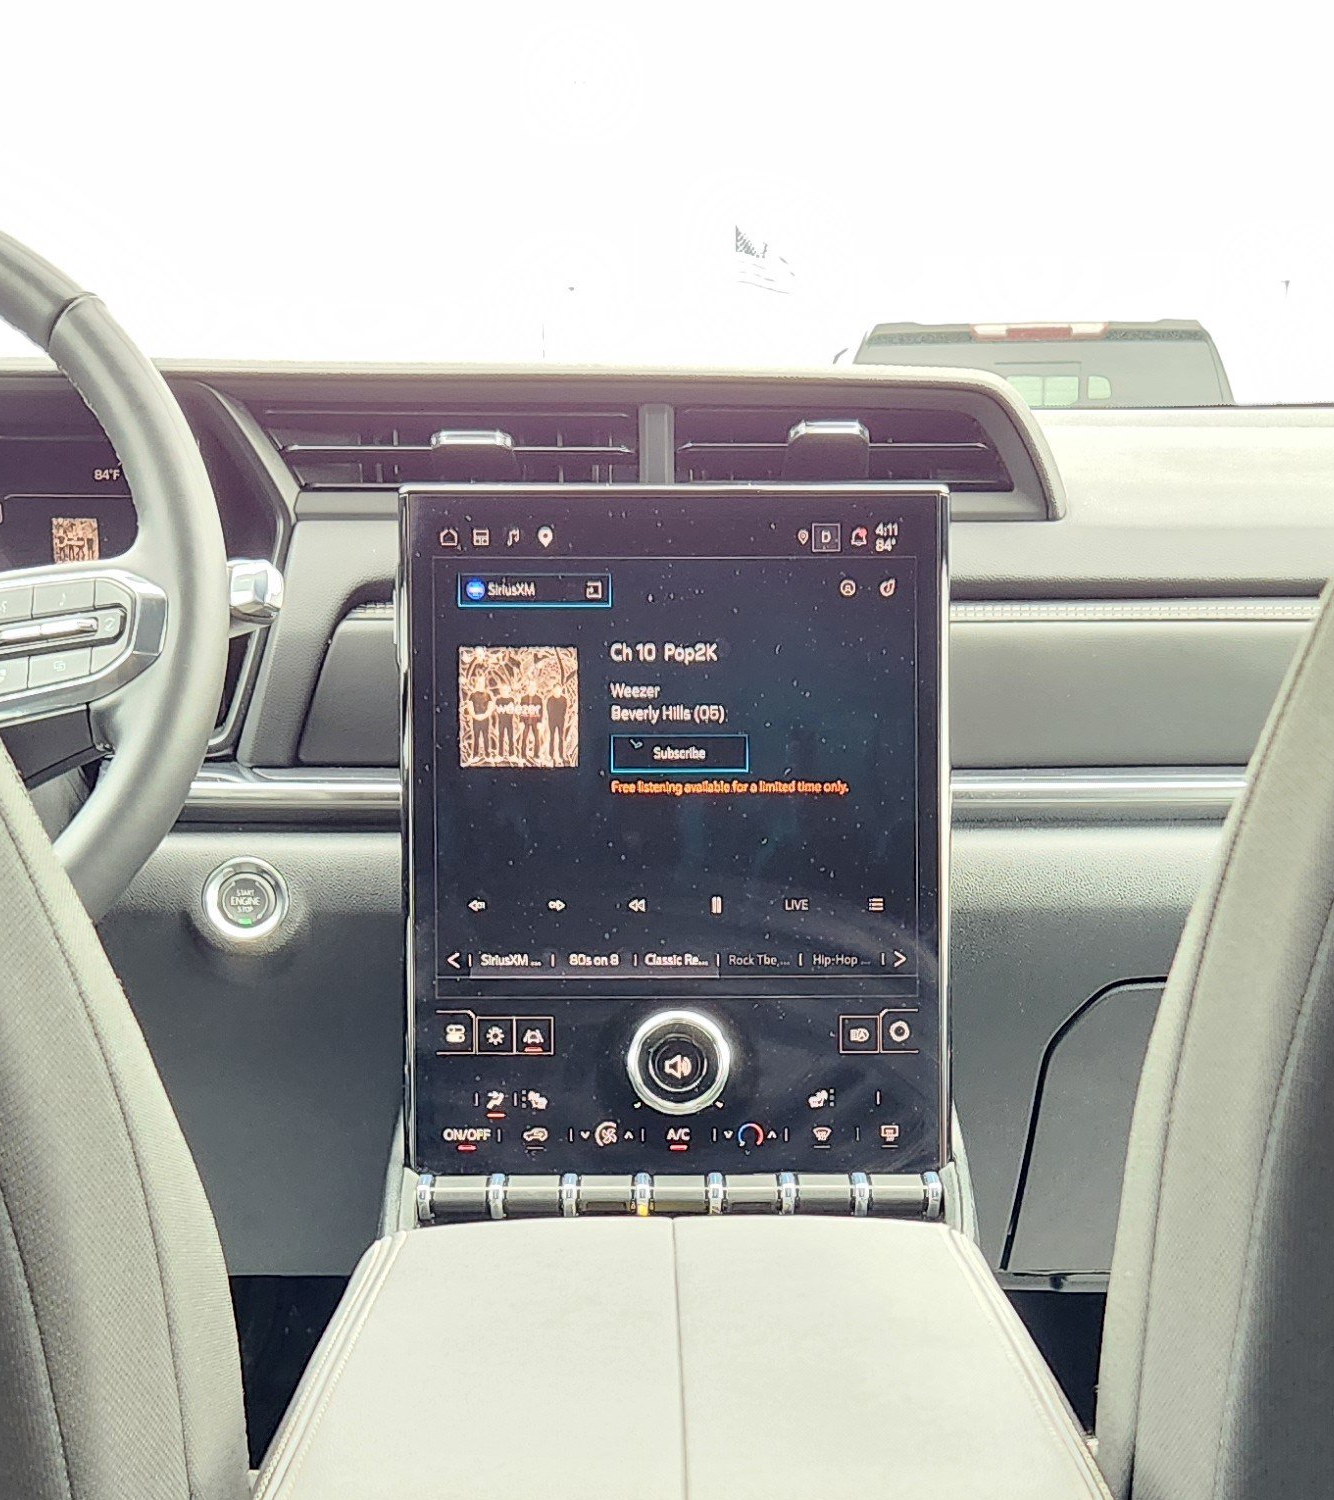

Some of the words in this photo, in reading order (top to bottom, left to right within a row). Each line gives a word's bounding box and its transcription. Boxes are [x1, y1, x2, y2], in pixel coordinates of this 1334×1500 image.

[821, 530, 832, 543] D
[875, 522, 899, 537] 4:11
[487, 580, 536, 597] SiriusXM
[610, 642, 633, 662] Ch
[635, 642, 656, 662] 10
[663, 642, 718, 665] Pop2K
[610, 682, 661, 699] Weezer
[610, 704, 660, 725] Beverly
[661, 704, 692, 721] Hills
[652, 746, 706, 761] Subscribe
[611, 780, 636, 794] Free
[637, 780, 683, 796] listening
[684, 780, 731, 794] available
[731, 780, 749, 793] for
[749, 783, 758, 793] a
[758, 780, 796, 793] limited
[797, 781, 822, 793] time
[823, 780, 849, 796] only.
[230, 896, 261, 906] ENGINE
[784, 898, 809, 911] LIVE
[480, 953, 529, 967] SiriusXM
[593, 955, 609, 966] on
[644, 953, 683, 966] Classic
[728, 953, 755, 966] Rock
[442, 1127, 491, 1141] ON/OFF
[667, 1128, 690, 1140] A/C
